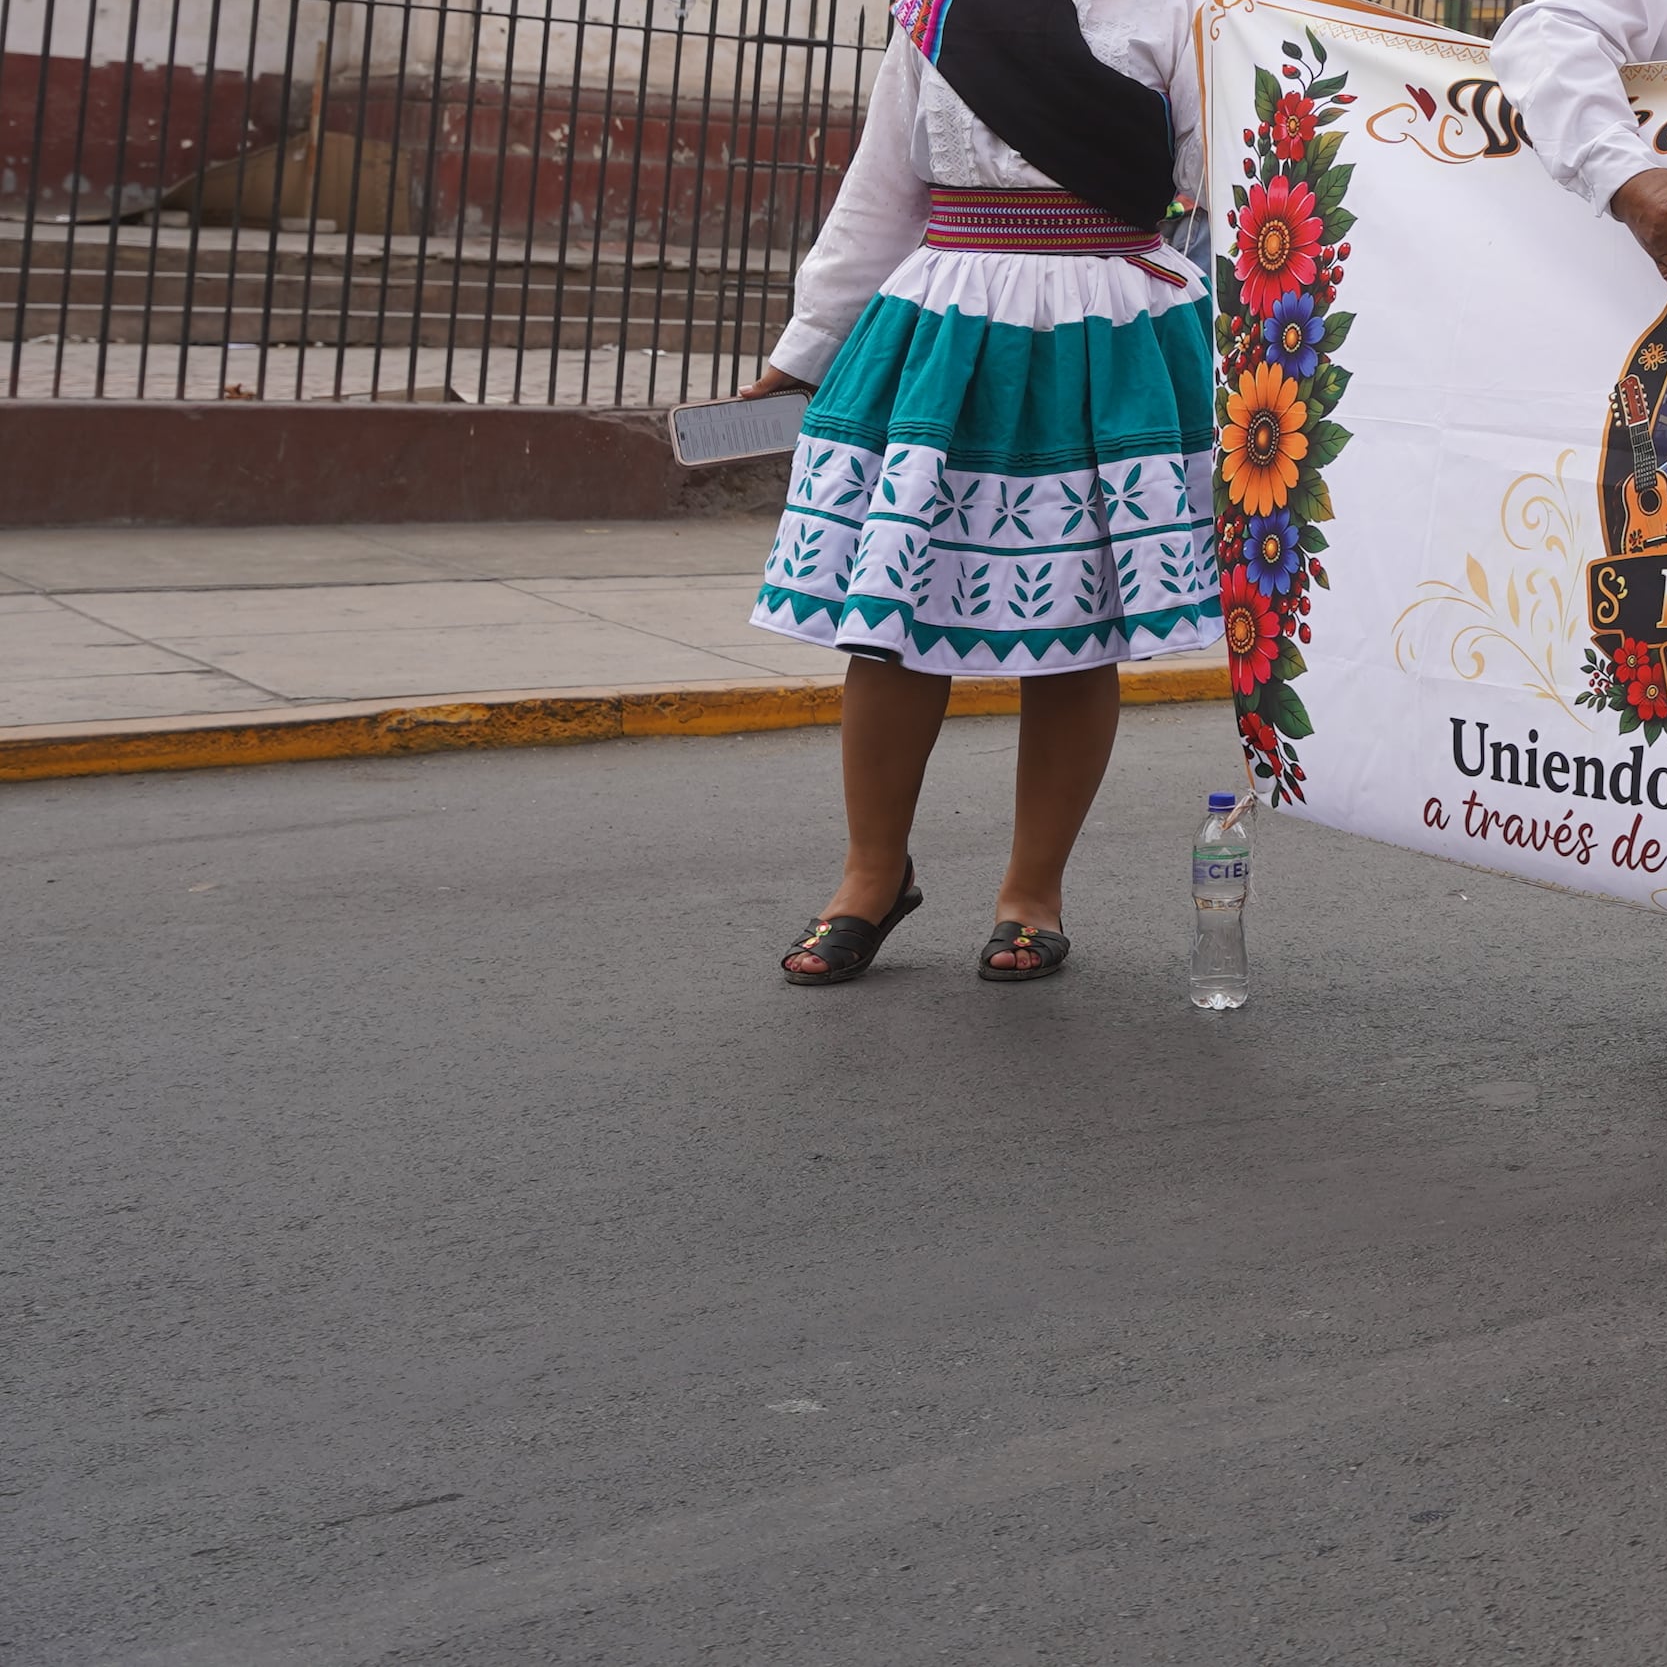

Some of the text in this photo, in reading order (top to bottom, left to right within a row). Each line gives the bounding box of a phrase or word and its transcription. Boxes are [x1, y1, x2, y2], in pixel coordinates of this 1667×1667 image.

[1423, 796, 1451, 831] a
[1462, 789, 1600, 865] través
[1611, 813, 1667, 874] de
